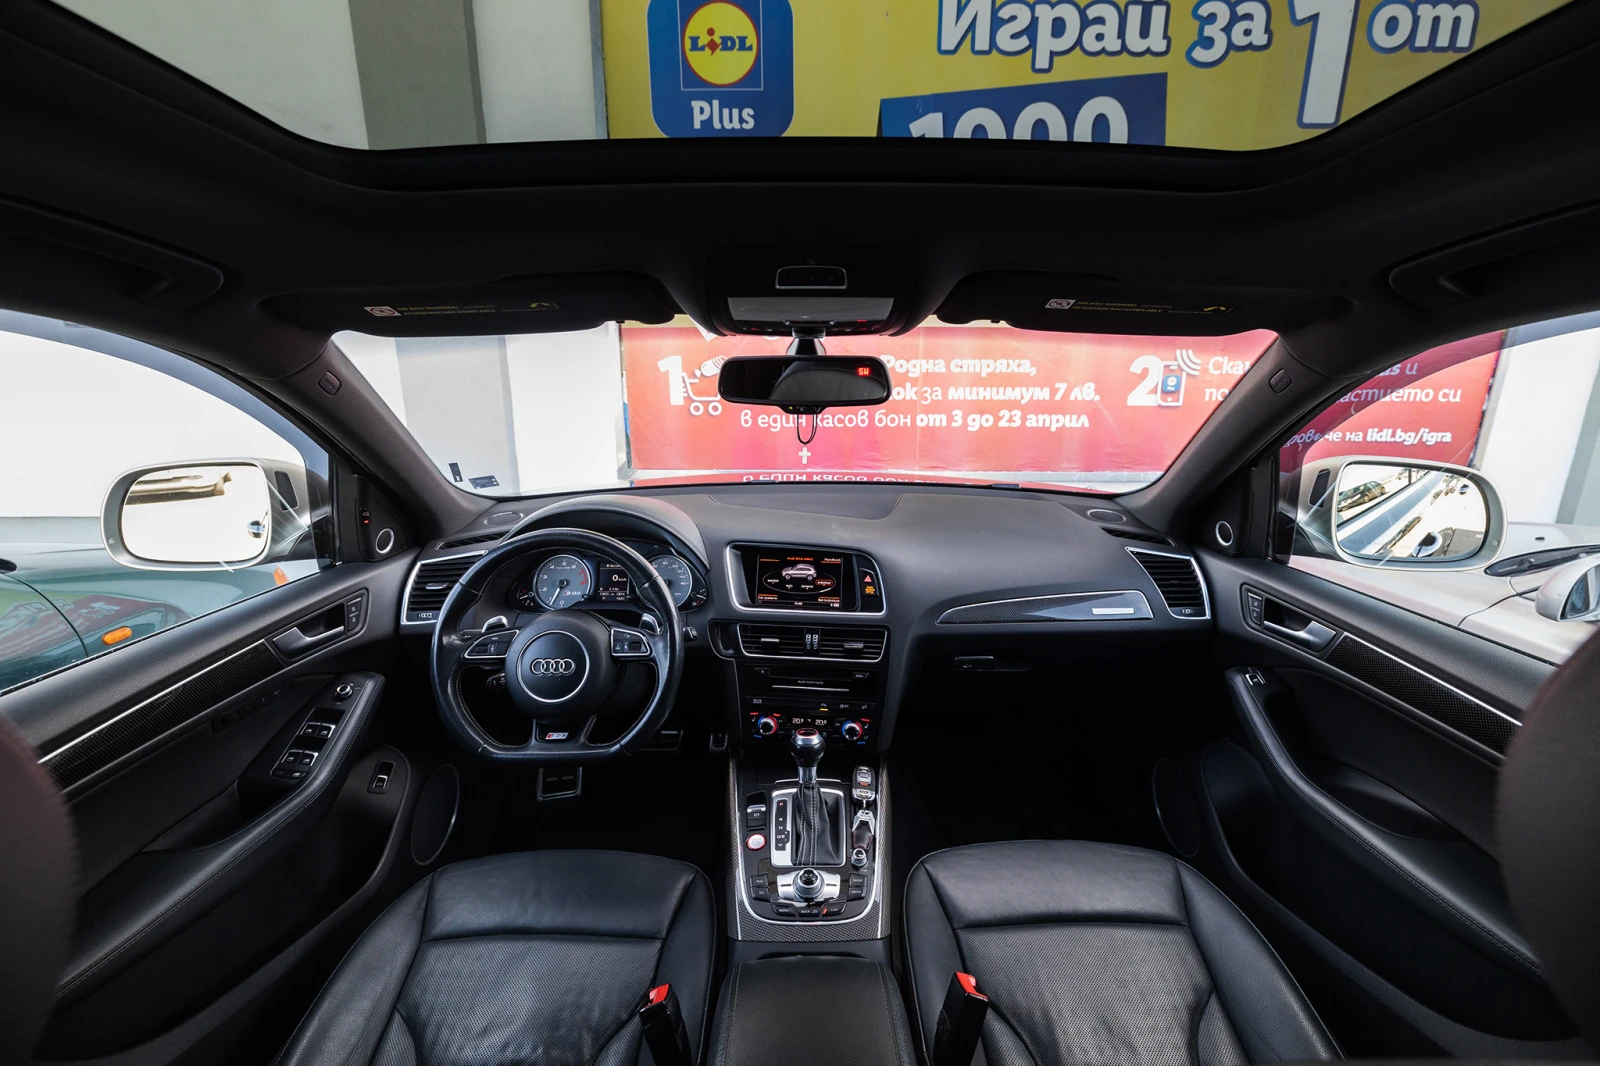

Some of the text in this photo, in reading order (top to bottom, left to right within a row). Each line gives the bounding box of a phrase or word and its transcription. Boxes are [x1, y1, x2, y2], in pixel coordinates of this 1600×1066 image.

[1191, 1, 1268, 63] за
[1293, 0, 1356, 124] 1
[1371, 3, 1475, 48] от
[691, 100, 755, 129] Plus
[858, 367, 869, 376] SW
[880, 355, 1036, 377] Родна стряха,
[1405, 363, 1418, 375] и
[657, 356, 683, 405] 1
[1127, 355, 1161, 406] 2
[889, 382, 1100, 404] ок за минимум 7 лв.
[1335, 388, 1462, 402] астието си
[741, 409, 1089, 432] в един касов бон от 3 до 23 април
[1345, 431, 1363, 442] на
[1366, 428, 1452, 446] lidl.bg/igra
